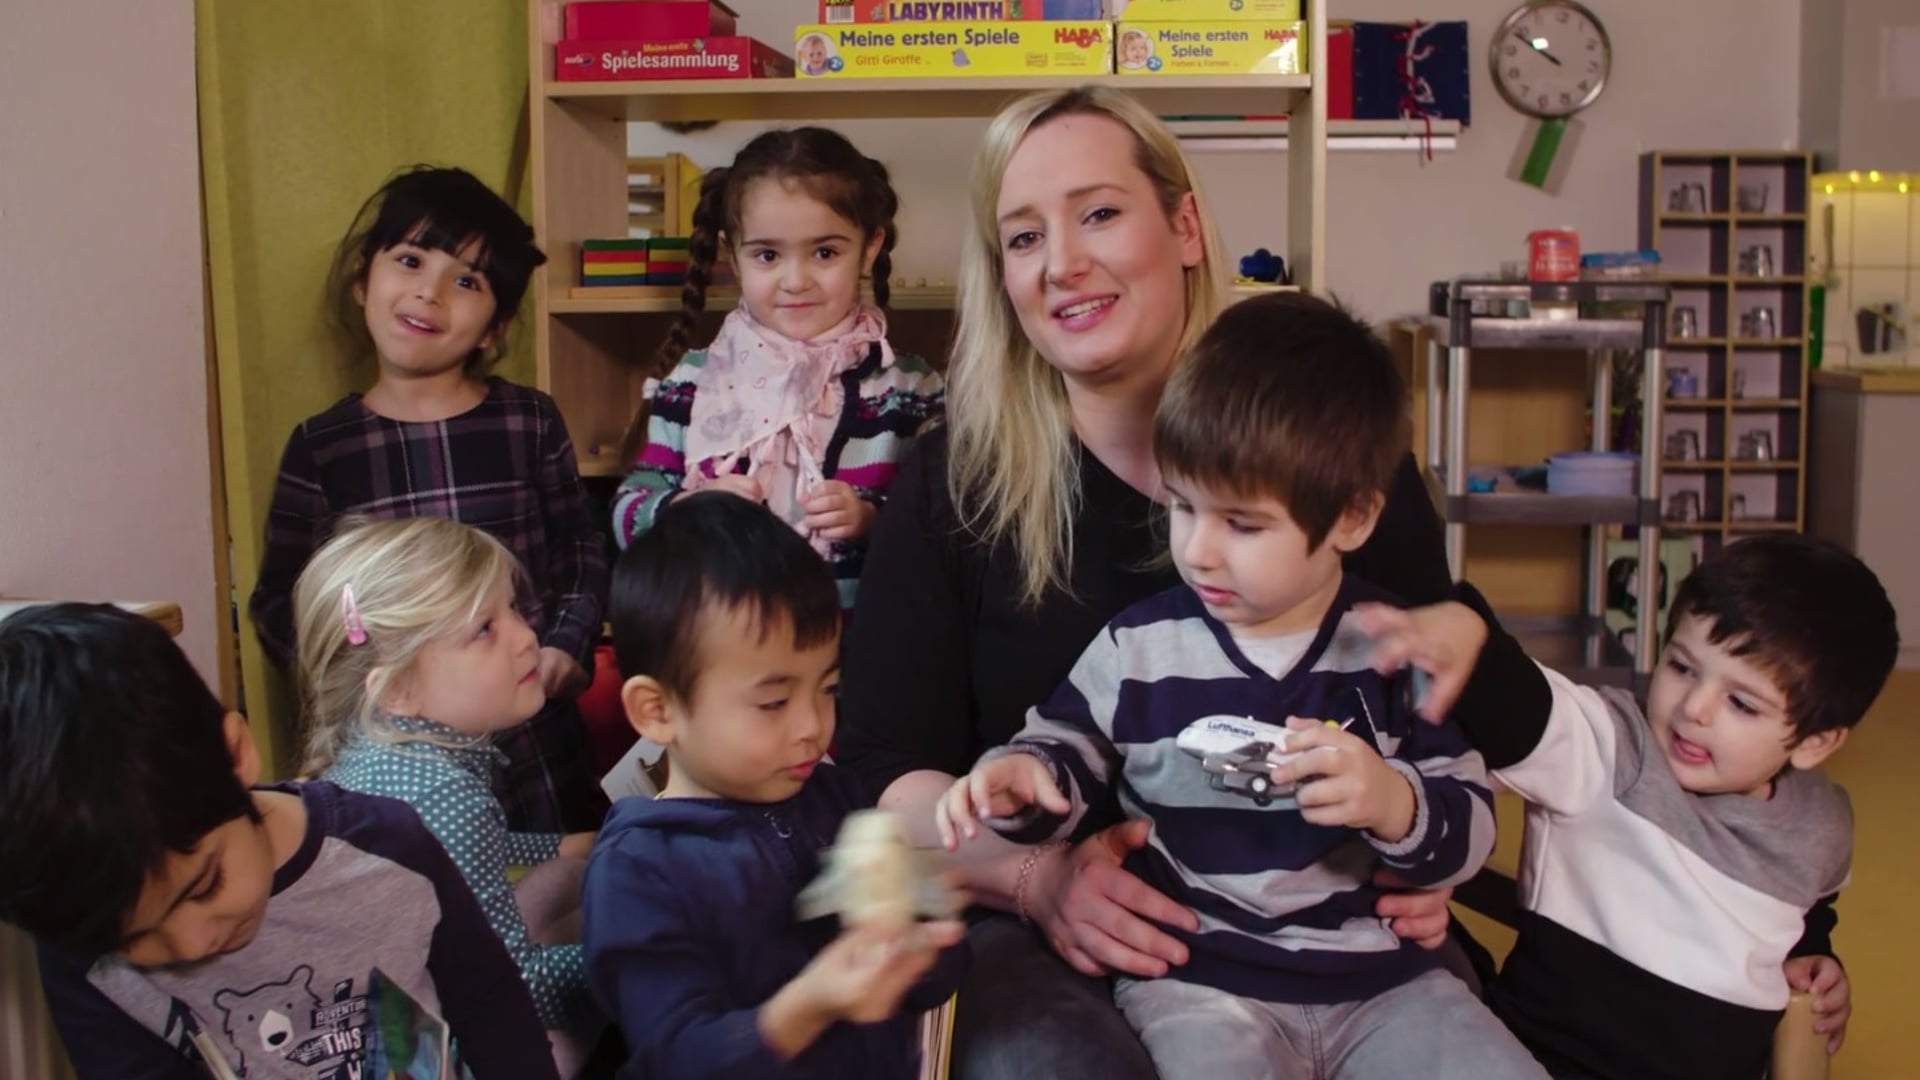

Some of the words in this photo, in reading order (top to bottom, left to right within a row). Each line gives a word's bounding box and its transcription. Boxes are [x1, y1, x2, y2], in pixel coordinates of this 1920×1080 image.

[889, 2, 1003, 21] LABYRINTH
[840, 31, 895, 47] Meine
[902, 31, 958, 46] ersten
[964, 28, 1020, 46] Spiele
[1055, 27, 1103, 48] HABA
[1159, 30, 1201, 42] Meine
[1206, 30, 1248, 41] ersten
[1171, 45, 1213, 58] Spiele
[601, 49, 740, 74] Spielesammlung
[855, 56, 881, 67] Gitti
[1207, 720, 1256, 737] Lufthansa
[321, 1027, 362, 1055] THIS
